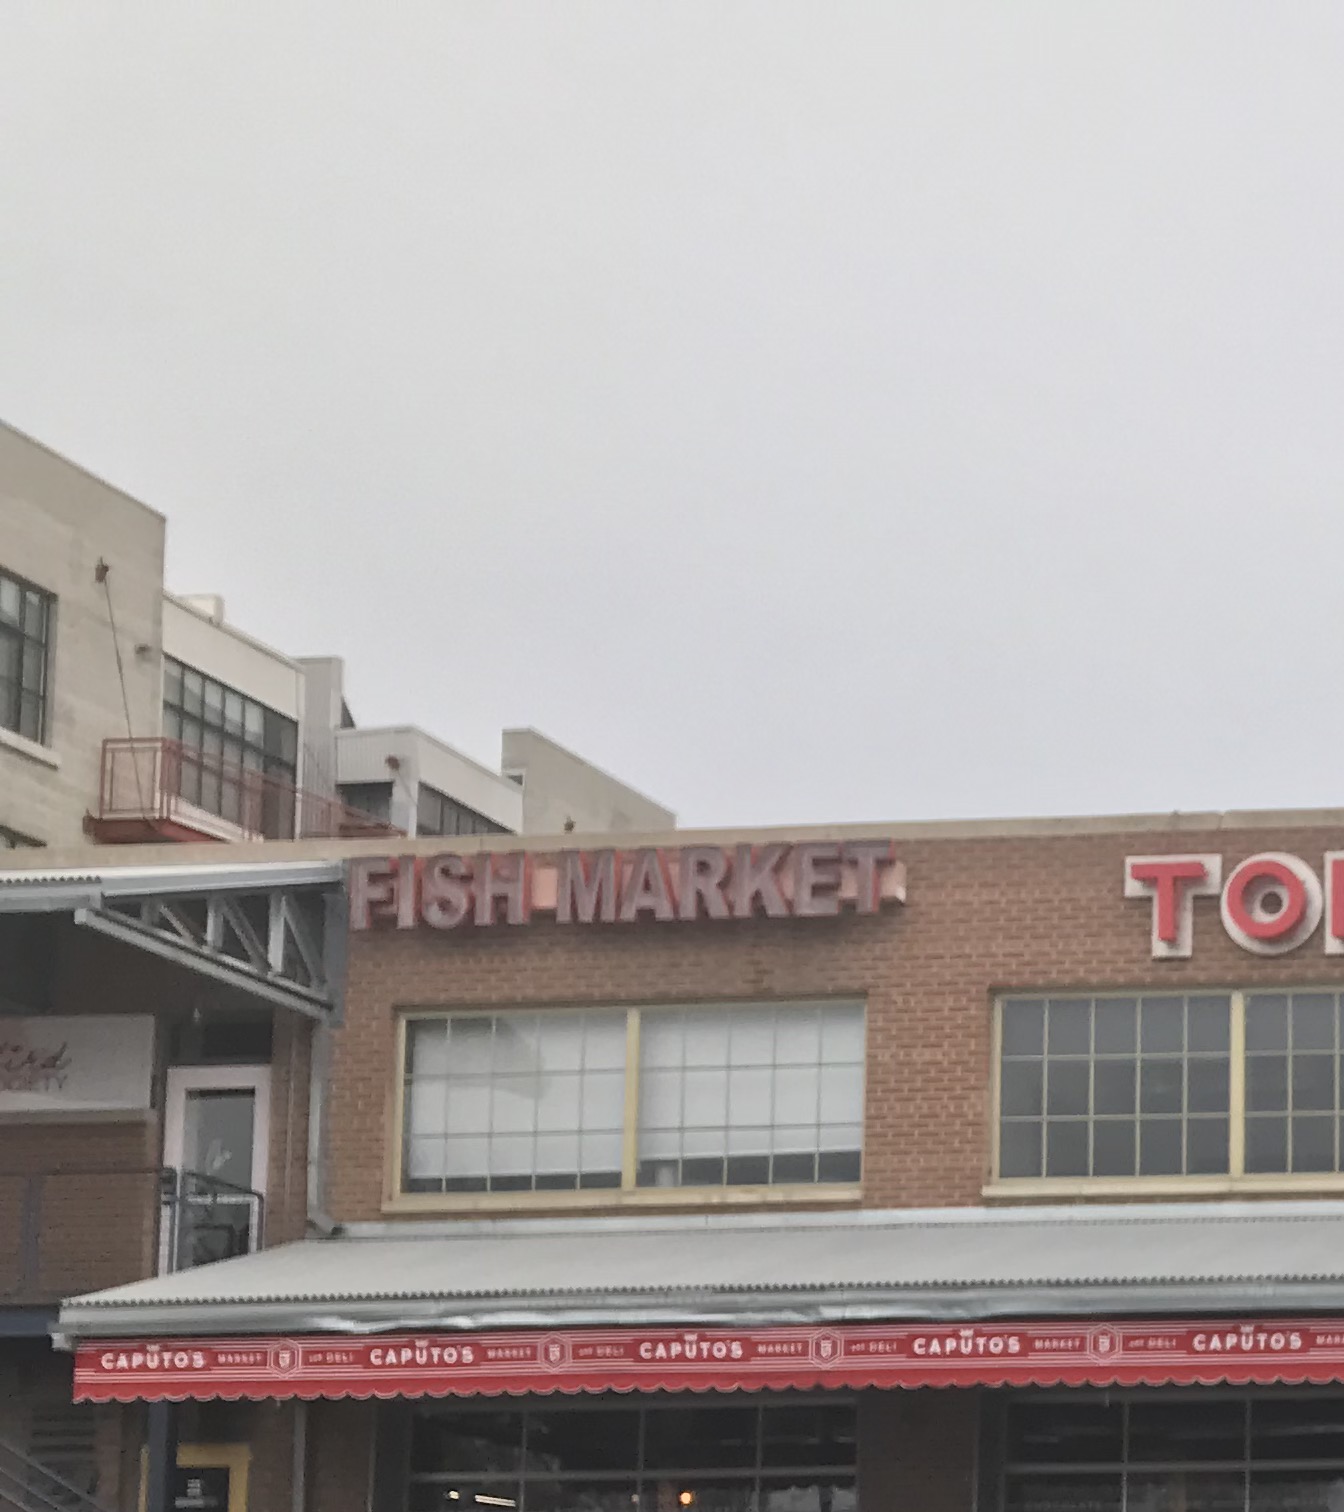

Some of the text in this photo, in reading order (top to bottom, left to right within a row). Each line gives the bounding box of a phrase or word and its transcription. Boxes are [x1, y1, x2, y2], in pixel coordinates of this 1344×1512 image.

[350, 840, 896, 930] FISH MARKET
[101, 1351, 205, 1370] CAPUTO'S
[217, 1353, 262, 1364] MARKET
[370, 1345, 474, 1366] CAPUTO'S
[487, 1348, 532, 1359] MARKET
[639, 1340, 743, 1360] CAPUTO'S
[757, 1343, 803, 1354] MARKET
[913, 1335, 1020, 1355] CAPUTO'S
[1034, 1338, 1080, 1350] MARKET
[1192, 1331, 1302, 1352] CAPUTO'S
